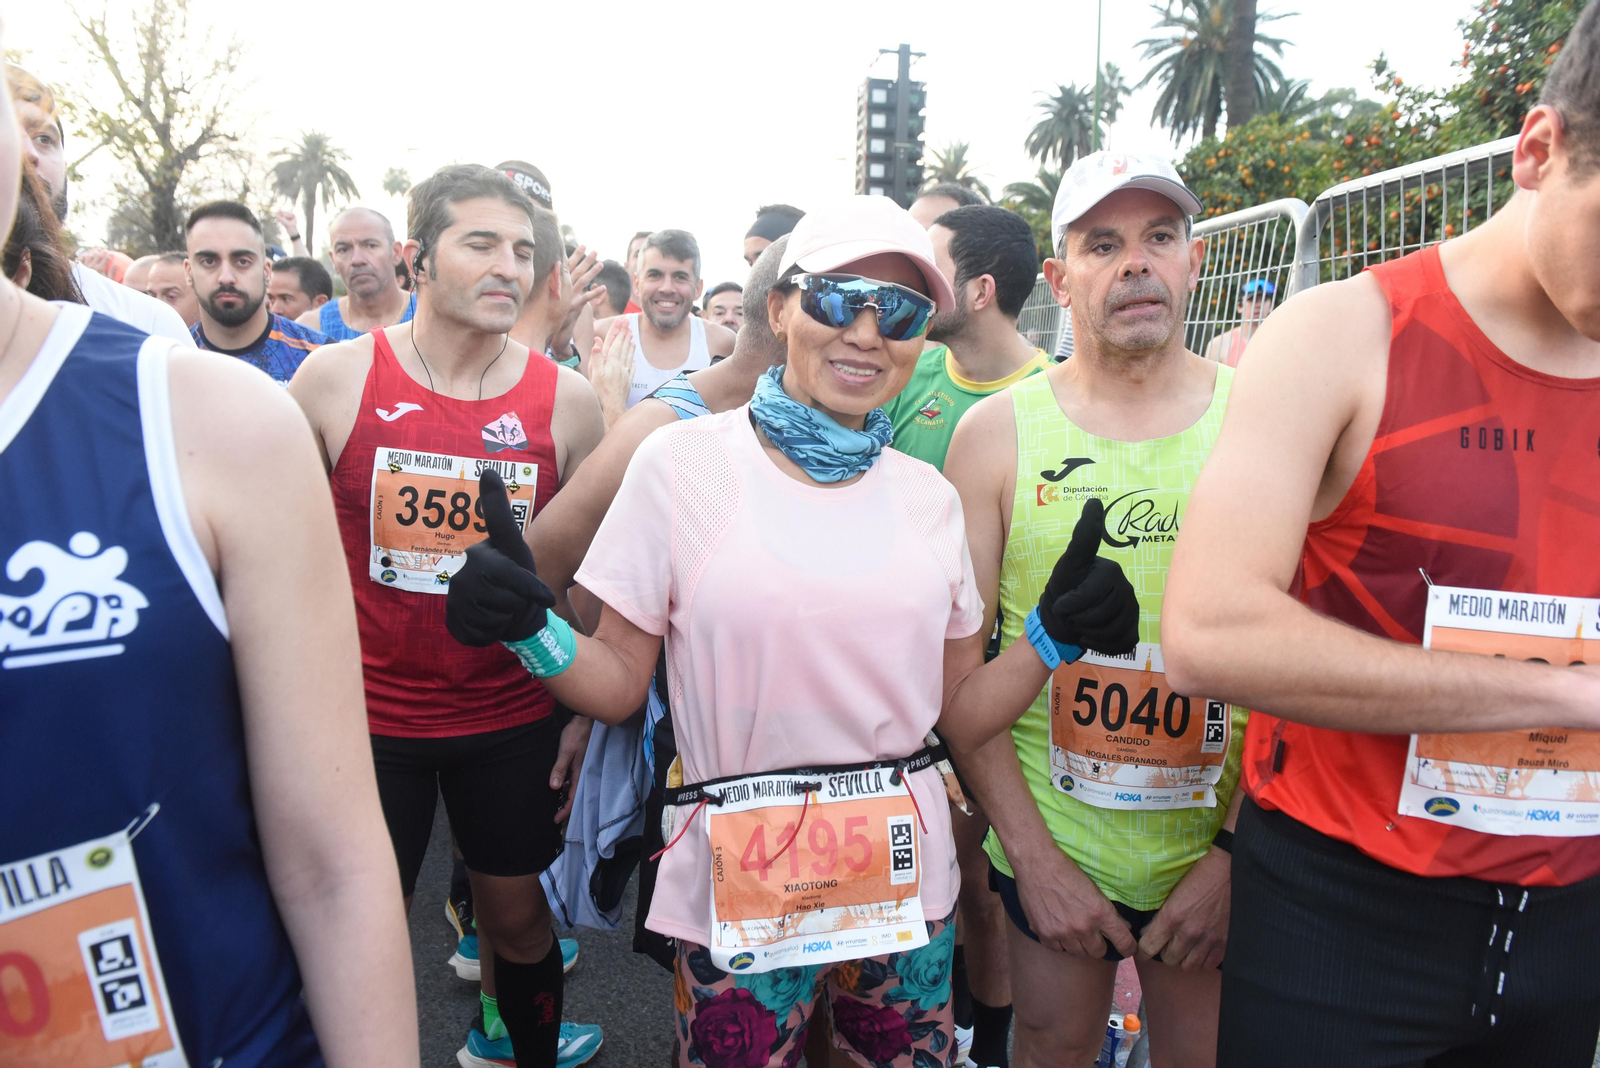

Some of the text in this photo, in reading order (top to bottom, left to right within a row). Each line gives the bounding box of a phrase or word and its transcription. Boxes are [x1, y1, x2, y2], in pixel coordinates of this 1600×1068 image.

[1460, 426, 1535, 452] GOBIK
[387, 451, 412, 466] MEDIO
[414, 454, 453, 471] MARATÓN
[1063, 485, 1108, 494] Diputación
[1063, 493, 1109, 502] de Córdoba
[435, 532, 455, 541] Hugo
[1141, 535, 1178, 543] META
[411, 545, 443, 554] Fernández
[1449, 593, 1493, 618] MEDIO
[1498, 598, 1567, 625] MARATÓN
[1072, 677, 1191, 739] 5040
[1106, 734, 1150, 747] CANDIDO
[1528, 732, 1568, 745] Miquel
[1085, 749, 1168, 766] NOGALES GRANADOS
[1517, 757, 1569, 768] Bauzá Miró
[719, 771, 885, 804] MEDIO MARATÓN SEVILLA
[1114, 792, 1142, 802] HOKA
[1525, 808, 1561, 822] HOKA
[739, 816, 873, 882] 4195
[715, 853, 724, 882] CAJÓN
[784, 879, 838, 893] XIAOTONG
[813, 901, 826, 909] Xie
[802, 940, 833, 954] HOKA
